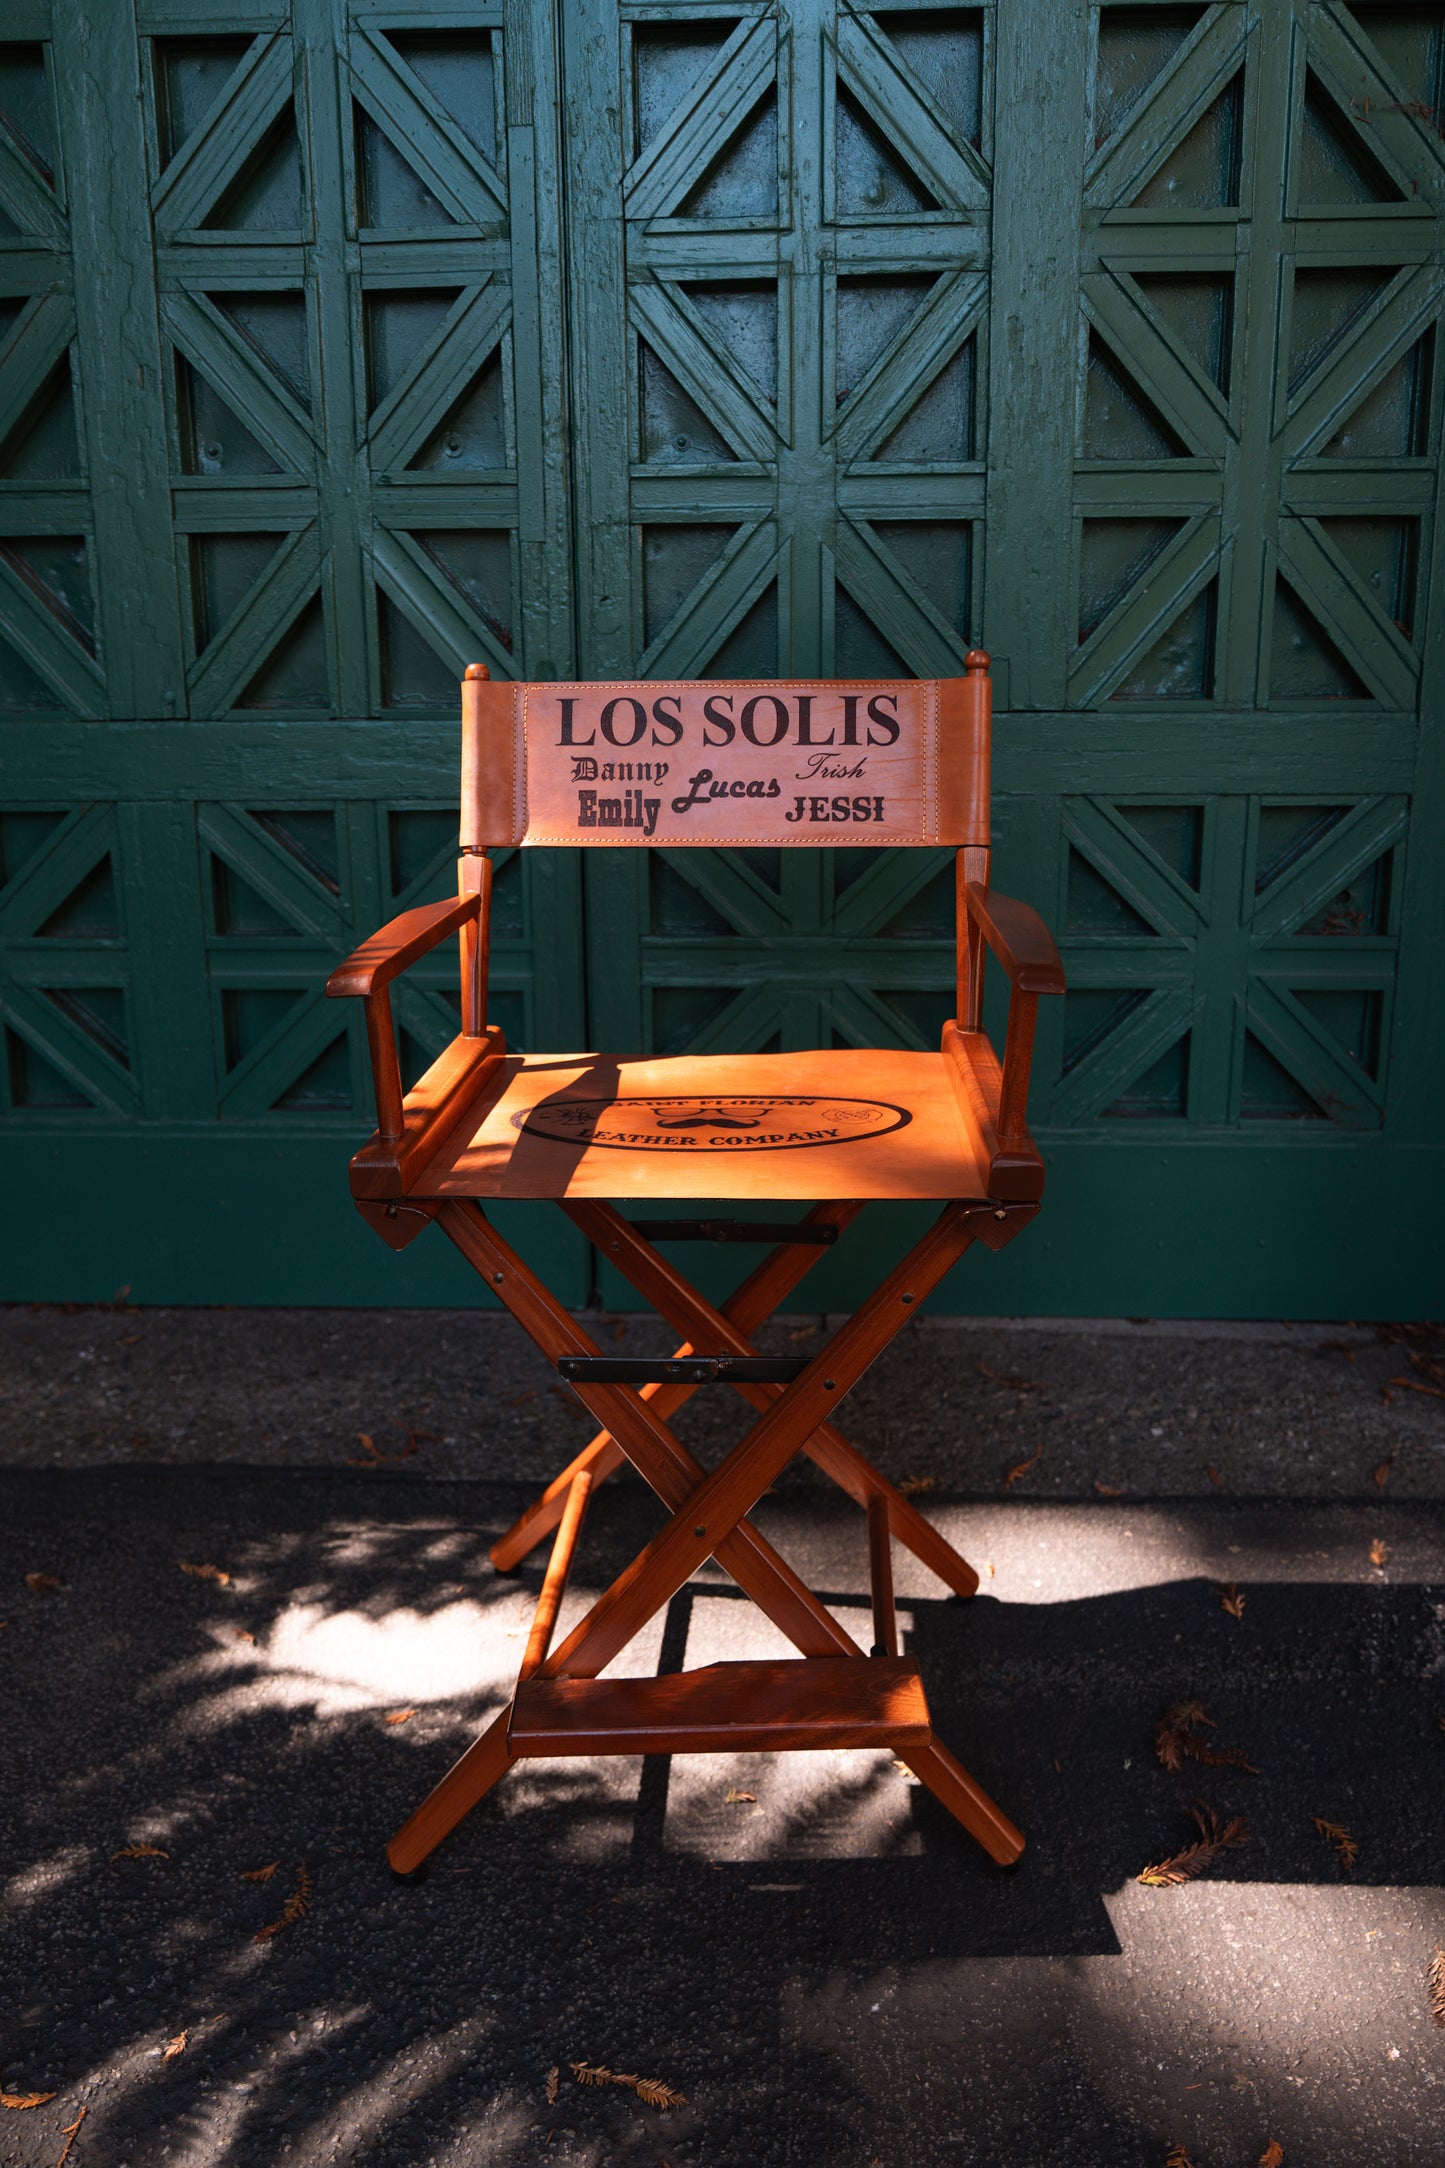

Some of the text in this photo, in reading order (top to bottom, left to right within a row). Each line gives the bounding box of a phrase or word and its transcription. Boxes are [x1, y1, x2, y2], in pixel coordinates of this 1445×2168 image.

[555, 694, 900, 748] LOS SOLIS
[570, 756, 669, 786] Danny
[795, 752, 868, 780] Trish
[671, 768, 781, 814] Lucas
[578, 790, 661, 836] Emily
[785, 796, 885, 823] JESSI
[576, 1128, 840, 1146] LEATHER COMPANY
